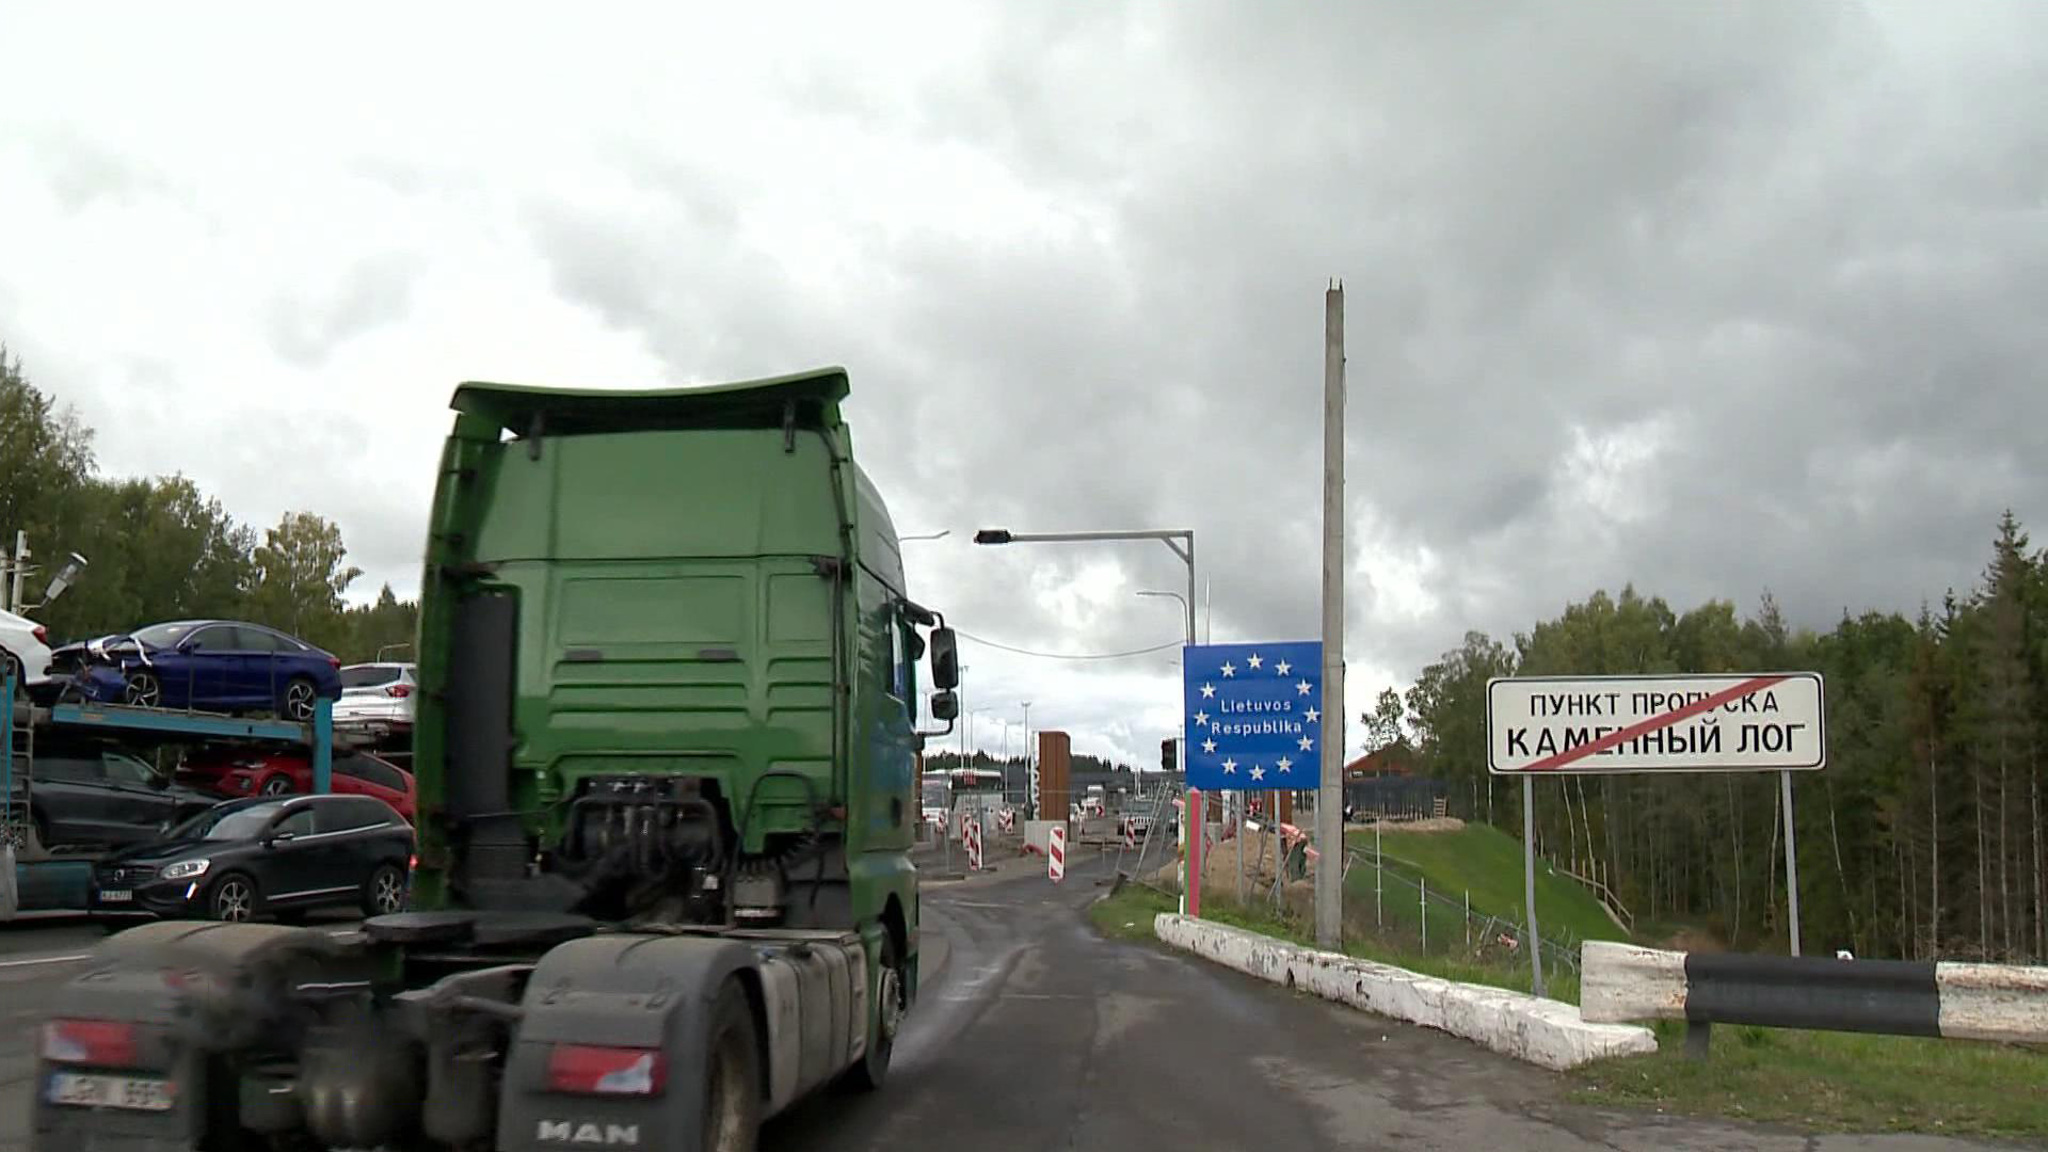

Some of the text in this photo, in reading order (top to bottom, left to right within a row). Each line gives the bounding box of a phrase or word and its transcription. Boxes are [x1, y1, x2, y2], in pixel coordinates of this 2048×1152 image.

[1220, 699, 1292, 713] Lietuvos
[1530, 693, 1621, 717] ПУНКТ
[1211, 719, 1302, 737] Respublika
[1736, 722, 1806, 754] ЛОГ
[537, 1120, 639, 1145] MAN
